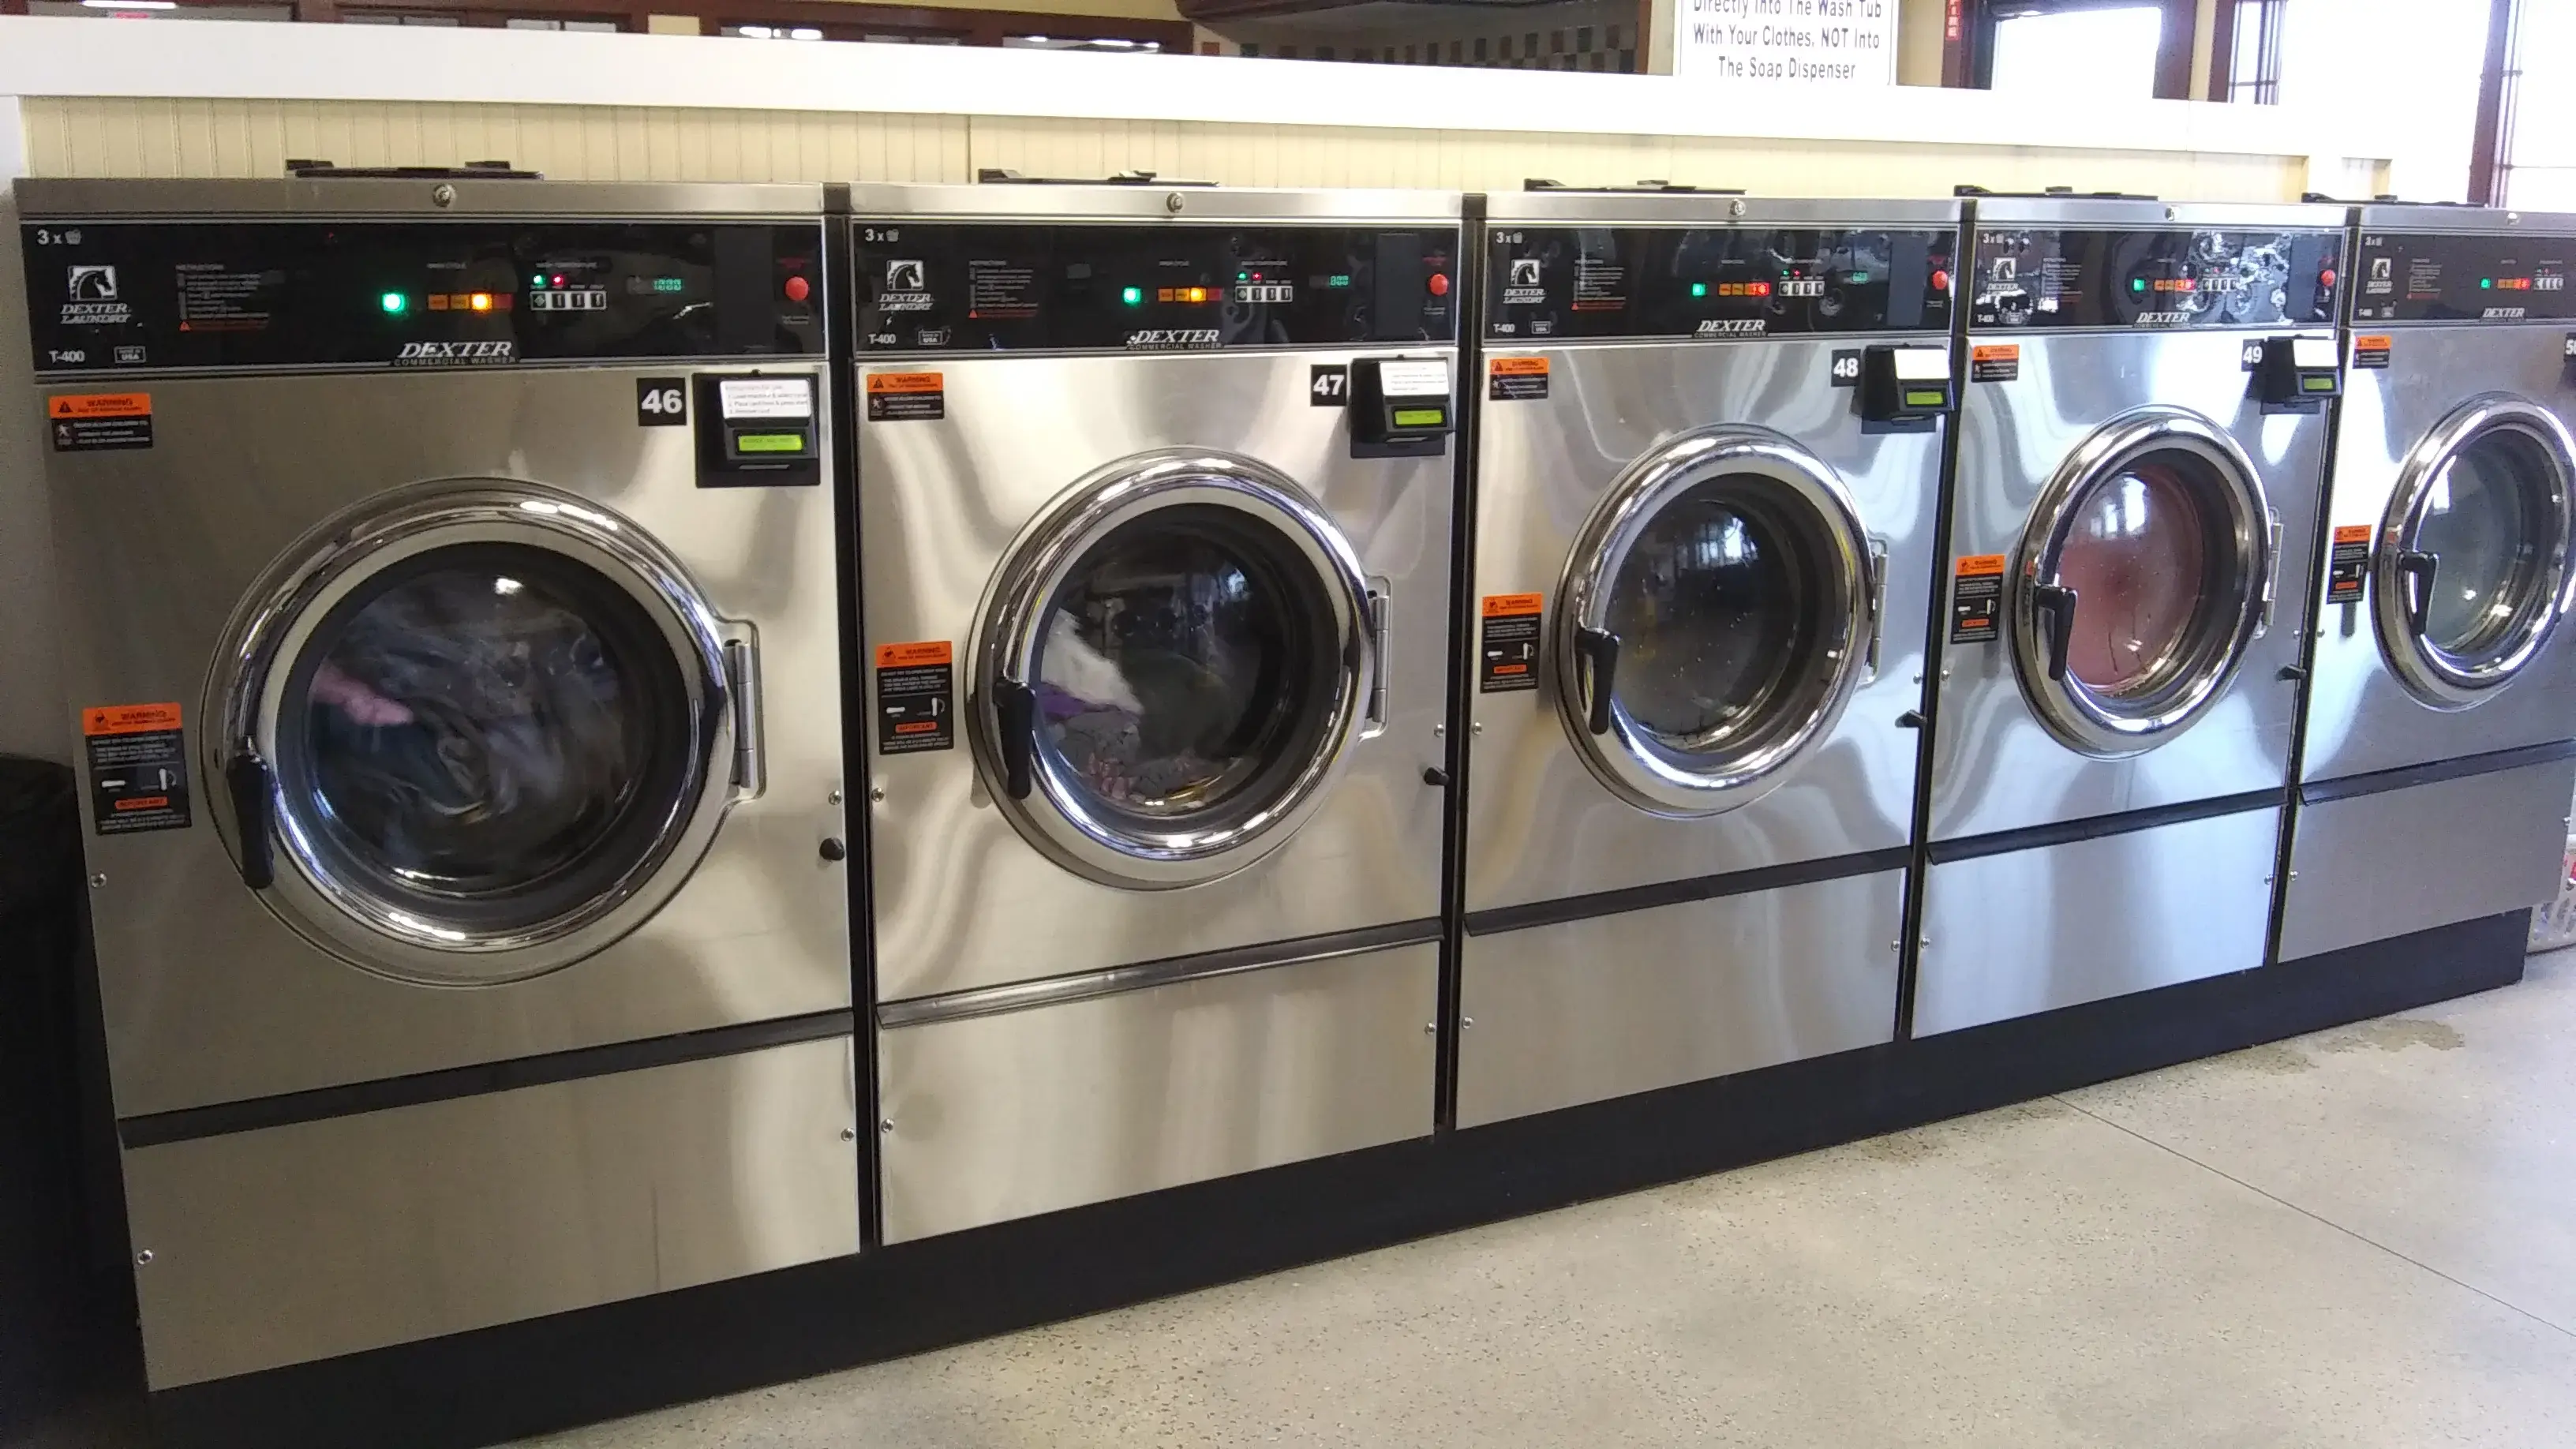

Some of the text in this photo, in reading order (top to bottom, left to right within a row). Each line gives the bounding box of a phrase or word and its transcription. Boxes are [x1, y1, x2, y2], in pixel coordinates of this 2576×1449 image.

[1694, 0, 1748, 19] Directly
[1754, 0, 1781, 14] Into
[1818, 0, 1852, 17] Wash
[1859, 0, 1881, 17] Tub
[1694, 23, 1723, 45] With
[1728, 24, 1758, 46] Your
[1821, 27, 1849, 48] NOT
[1855, 28, 1880, 49] Into
[1719, 55, 1855, 82] The Soap Dispenser
[37, 230, 49, 245] 3
[864, 228, 874, 242] 3
[879, 294, 931, 302] DEXTER
[60, 303, 128, 315] DEXTER
[2482, 308, 2525, 318] DEXTER
[2136, 312, 2191, 323] DEXTER
[1696, 320, 1766, 331] DEXTER
[868, 334, 897, 344] T-400
[1134, 330, 1220, 344] DEXTER
[49, 350, 85, 363] T-400
[397, 341, 512, 358] DEXTER
[2243, 346, 2263, 364] 49
[1833, 358, 1859, 377] 48
[1312, 374, 1345, 395] 47
[641, 388, 683, 414] 46
